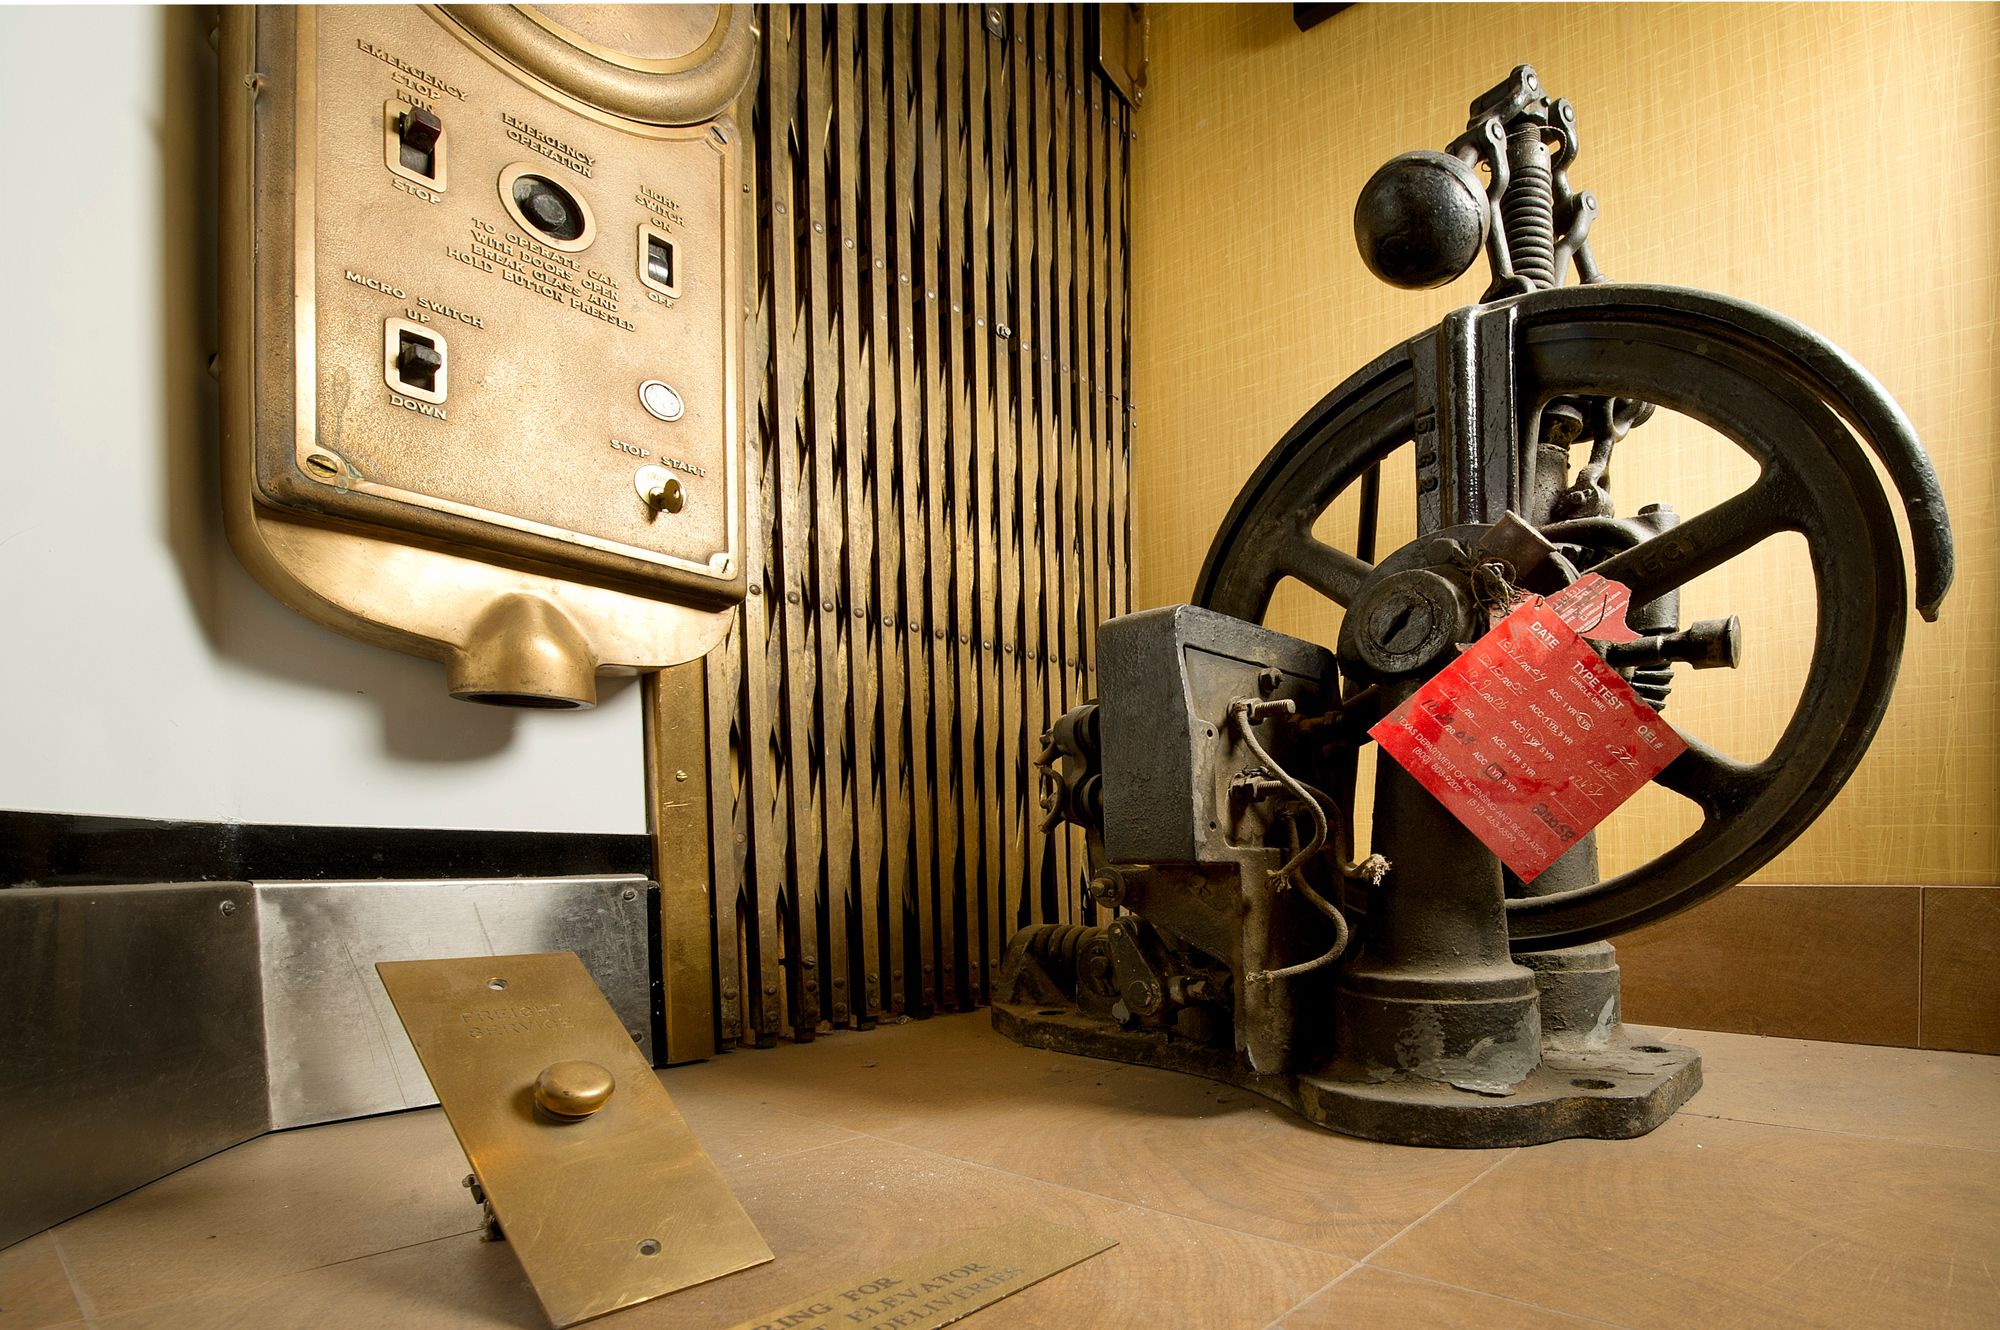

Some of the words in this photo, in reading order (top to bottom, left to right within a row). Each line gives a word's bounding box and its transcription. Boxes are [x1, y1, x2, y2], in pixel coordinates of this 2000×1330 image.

[357, 39, 468, 101] EMERGENCY
[392, 71, 441, 101] STOP
[397, 89, 434, 114] RUN
[502, 113, 595, 166] EMERGENCY
[506, 129, 593, 178] OPERATION
[392, 178, 441, 205] STOP
[641, 185, 680, 211] LIGHT
[635, 195, 686, 227] SWITCH
[651, 217, 672, 234] ON
[471, 217, 498, 234] TO
[506, 233, 580, 271] OPERATE
[588, 269, 620, 289] CAR
[471, 230, 514, 256] WITH
[521, 251, 573, 282] DOORS
[582, 279, 620, 302] OPEN
[446, 246, 494, 274] HOLD
[502, 270, 564, 303] BUTTON
[571, 299, 636, 332] PRESSED
[471, 244, 526, 274] BREAK
[532, 268, 581, 297] GLASS
[589, 292, 618, 312] AND
[345, 270, 406, 299] MICRO
[417, 297, 484, 329] SWITCH
[648, 291, 674, 309] OFF
[405, 308, 430, 324] UP
[389, 394, 447, 420] DOWN
[610, 438, 650, 459] STOP
[660, 455, 706, 478] START
[1530, 621, 1559, 648] DATE
[1571, 661, 1599, 687] TYPE
[1596, 685, 1624, 711] TEST
[1635, 724, 1659, 745] QEI
[1546, 687, 1563, 702] ACC
[1566, 674, 1593, 698] (CIRCLE
[1589, 695, 1607, 712] ONE)
[1509, 718, 1526, 733] ACC
[1528, 702, 1545, 718] ACC
[1471, 749, 1489, 765] ACC
[1490, 734, 1507, 749] ACC
[1396, 715, 1418, 735] TEXAS
[1415, 733, 1456, 771] DEPARTMENT
[1453, 769, 1466, 781] OF
[1463, 779, 1497, 811] LICENSING
[1495, 809, 1512, 825] AND
[1509, 822, 1548, 859] REGULATION
[1412, 745, 1432, 764] (800)
[1429, 762, 1463, 793] 803-9202
[1466, 797, 1486, 815] (512)
[1484, 814, 1517, 844] 463-6599
[461, 1004, 563, 1025] FREIGHT
[466, 1016, 576, 1039] SERVICE
[839, 1277, 902, 1302] FOR
[845, 1262, 990, 1323] ELEVATOR
[872, 1265, 1025, 1330] DELIVERIES
